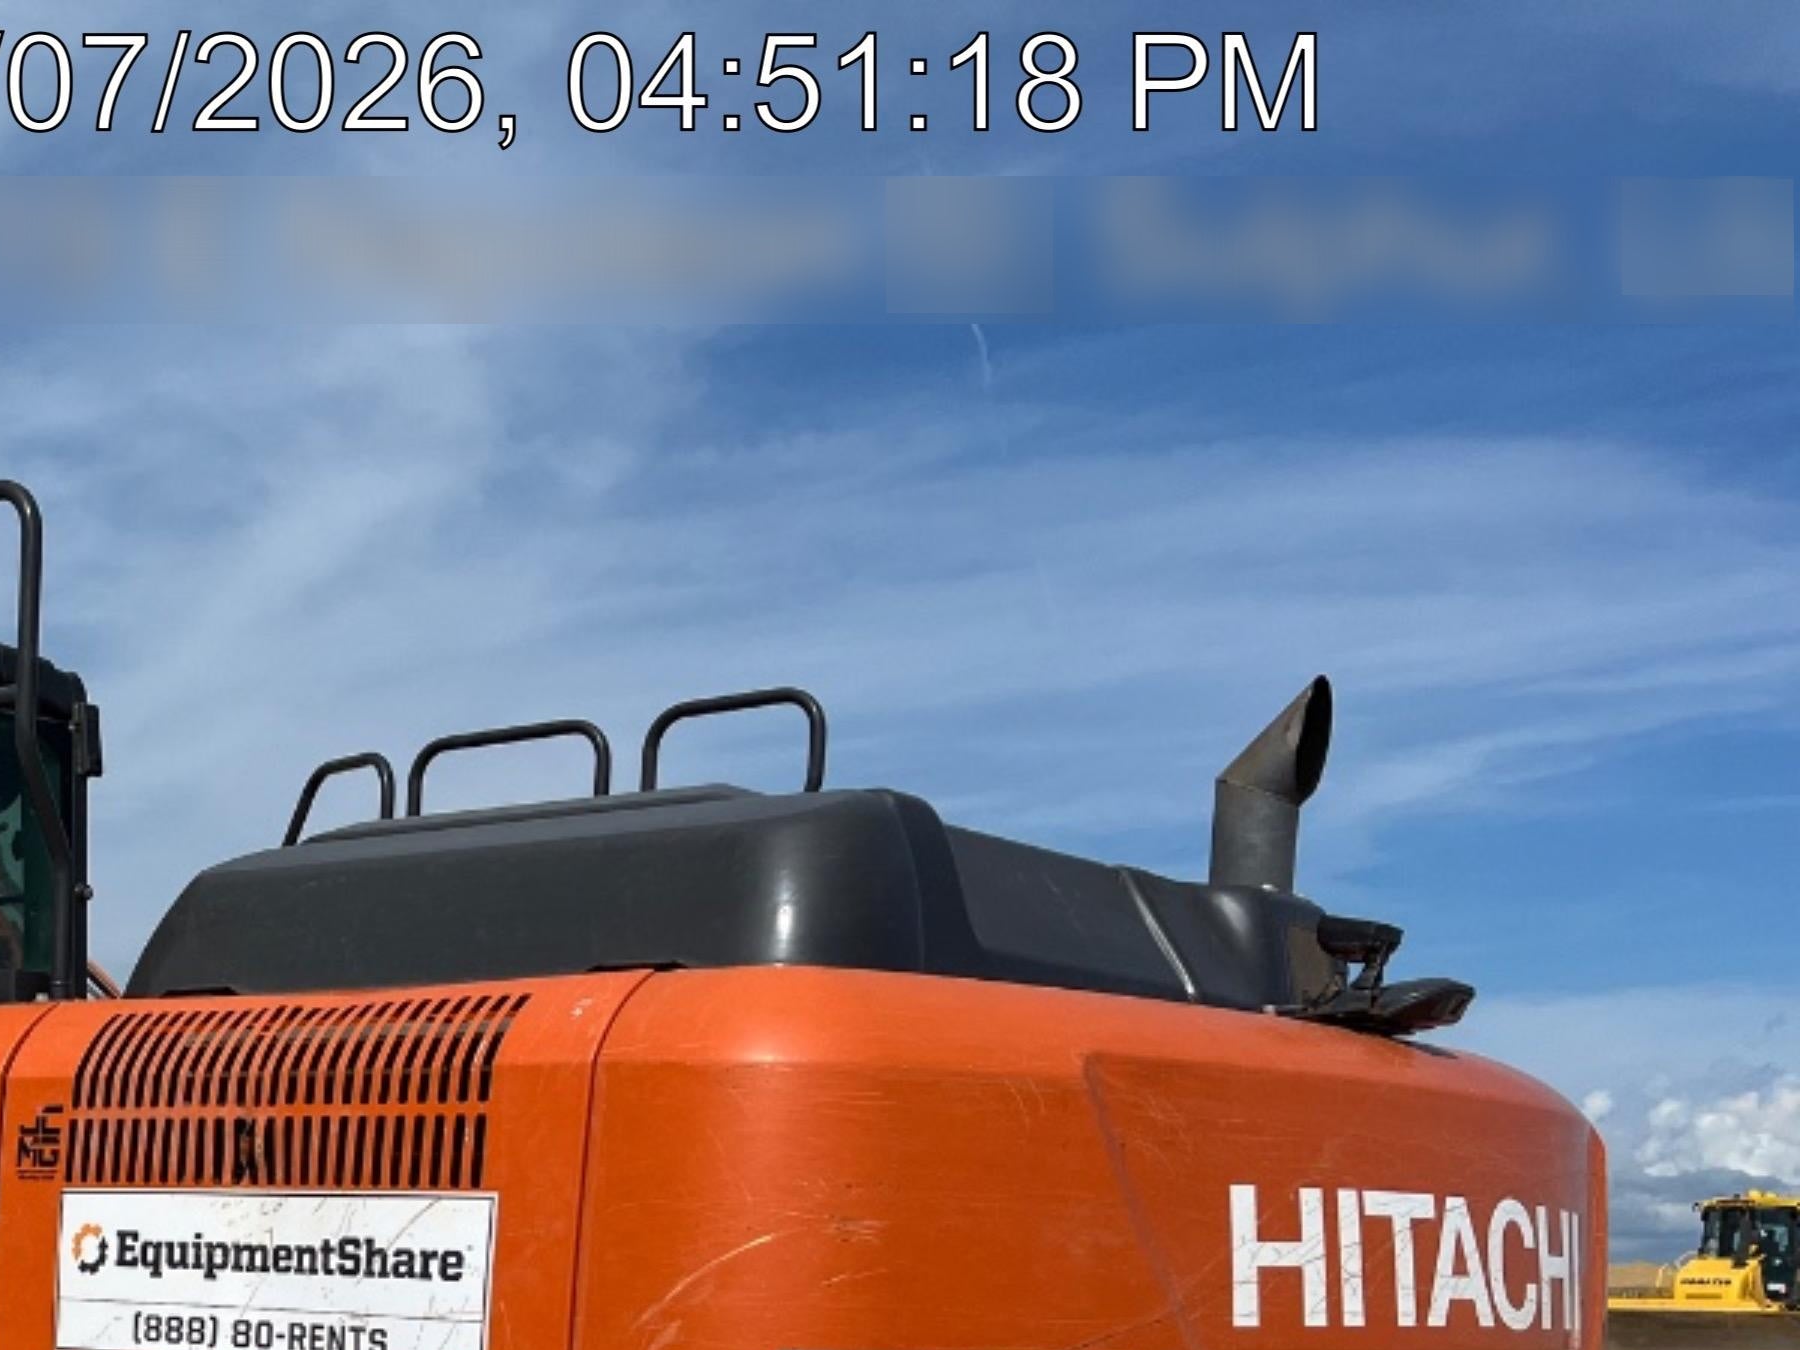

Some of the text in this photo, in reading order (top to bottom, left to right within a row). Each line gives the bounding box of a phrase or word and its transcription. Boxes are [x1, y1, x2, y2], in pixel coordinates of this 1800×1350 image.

[114, 1228, 466, 1282] EquipmentShare
[1228, 1183, 1582, 1331] HITACHI
[132, 1310, 219, 1349] (888)
